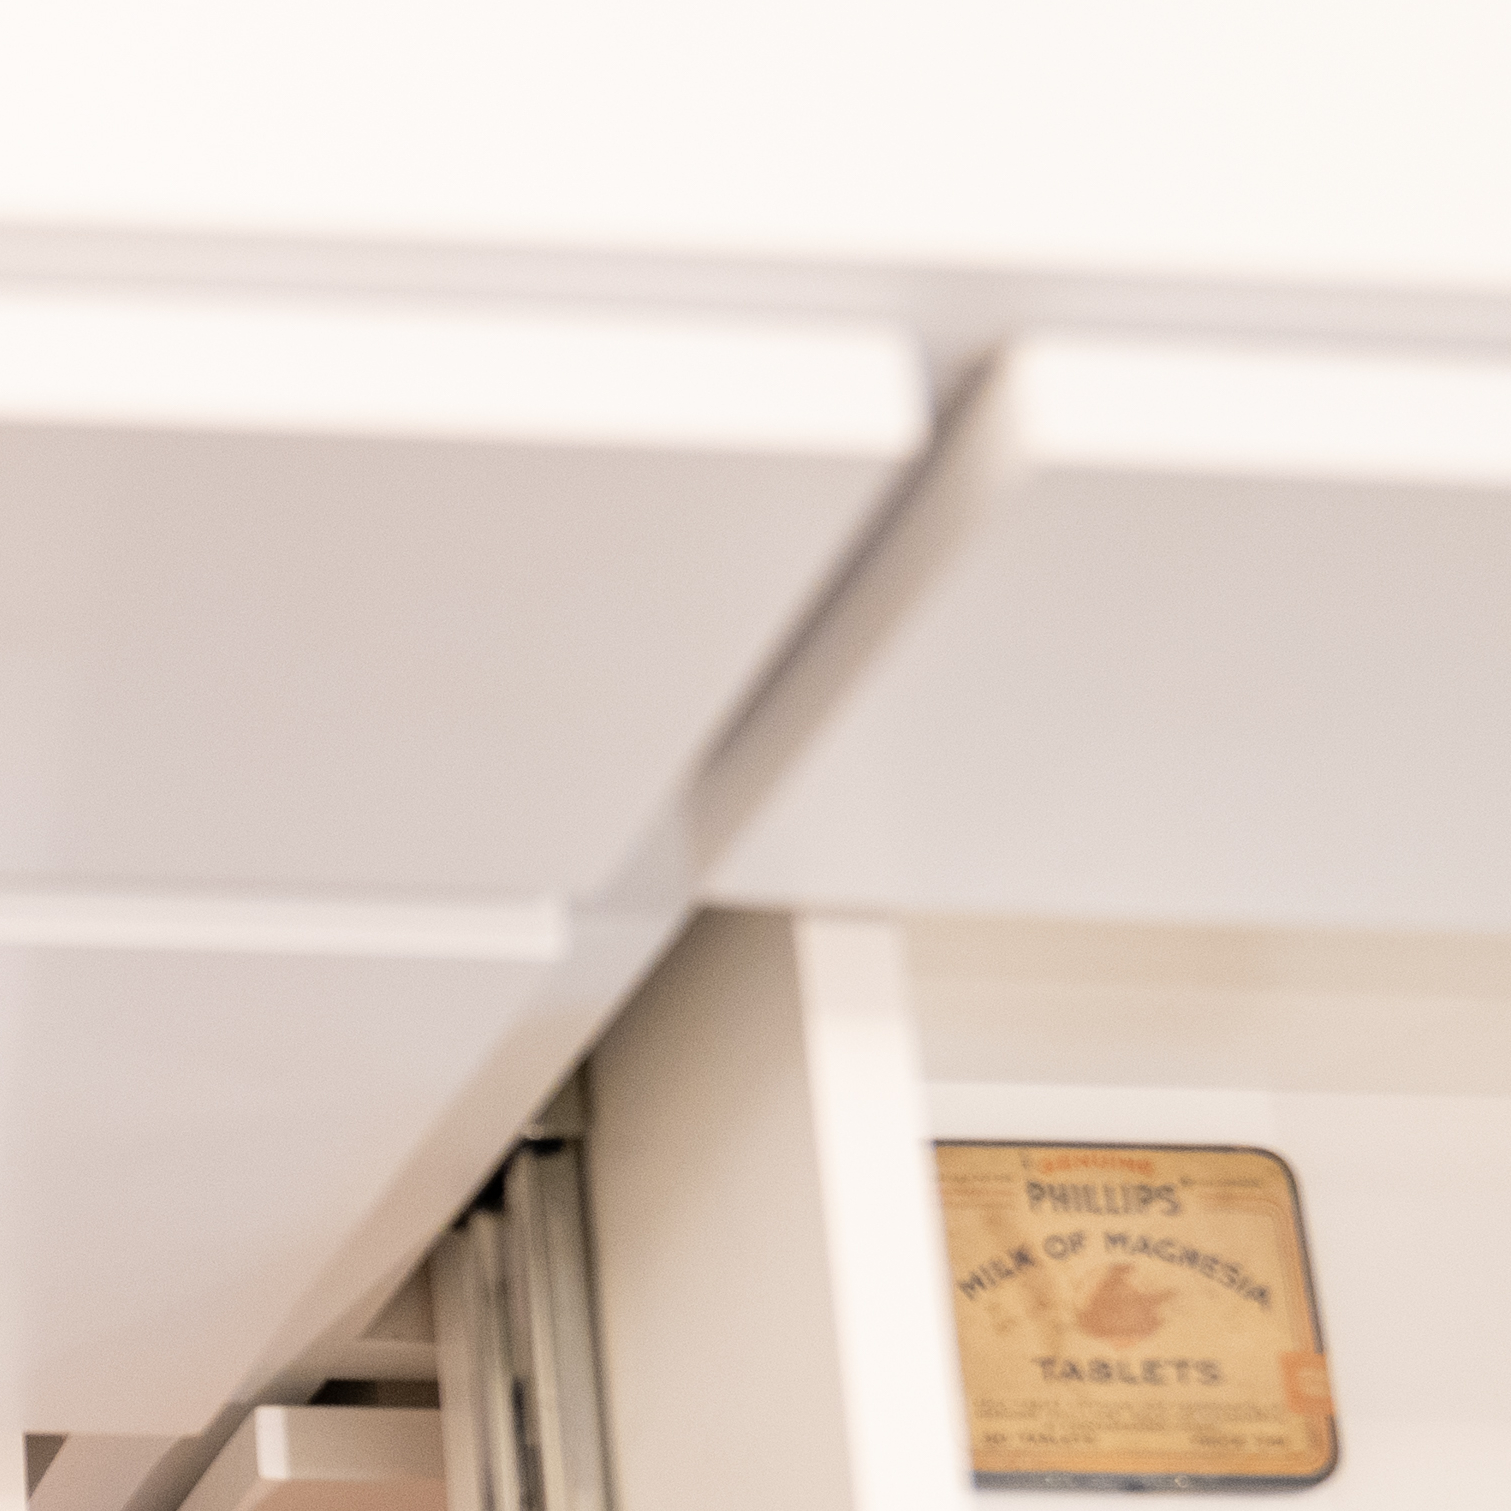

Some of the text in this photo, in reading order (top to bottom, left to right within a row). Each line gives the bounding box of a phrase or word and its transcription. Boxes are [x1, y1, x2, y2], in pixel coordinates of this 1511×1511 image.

[958, 1230, 1272, 1311] MILK OF MAGNESIA
[1033, 1354, 1224, 1388] TABLETS
